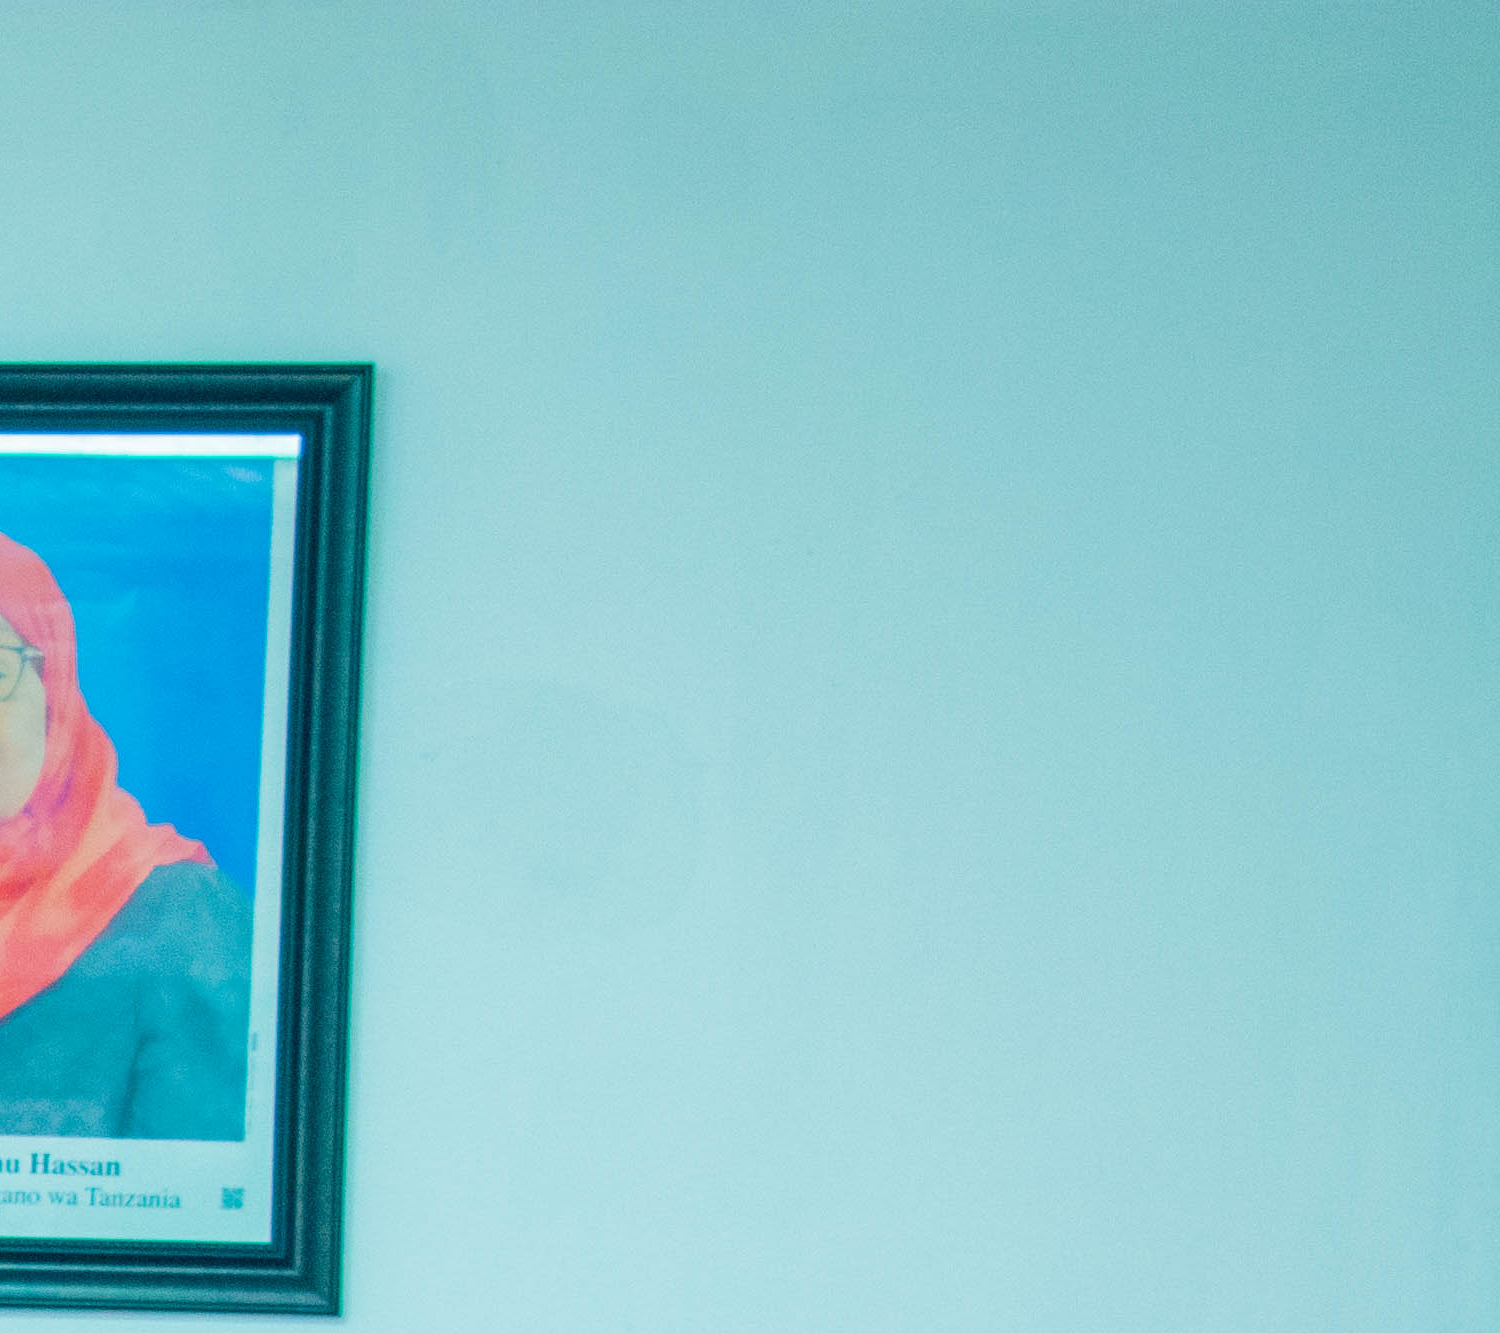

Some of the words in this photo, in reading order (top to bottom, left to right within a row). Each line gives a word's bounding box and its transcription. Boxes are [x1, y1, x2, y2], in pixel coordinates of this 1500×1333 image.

[29, 1153, 122, 1178] Hassan
[48, 1190, 79, 1206] wa
[84, 1187, 182, 1209] Tanzania
